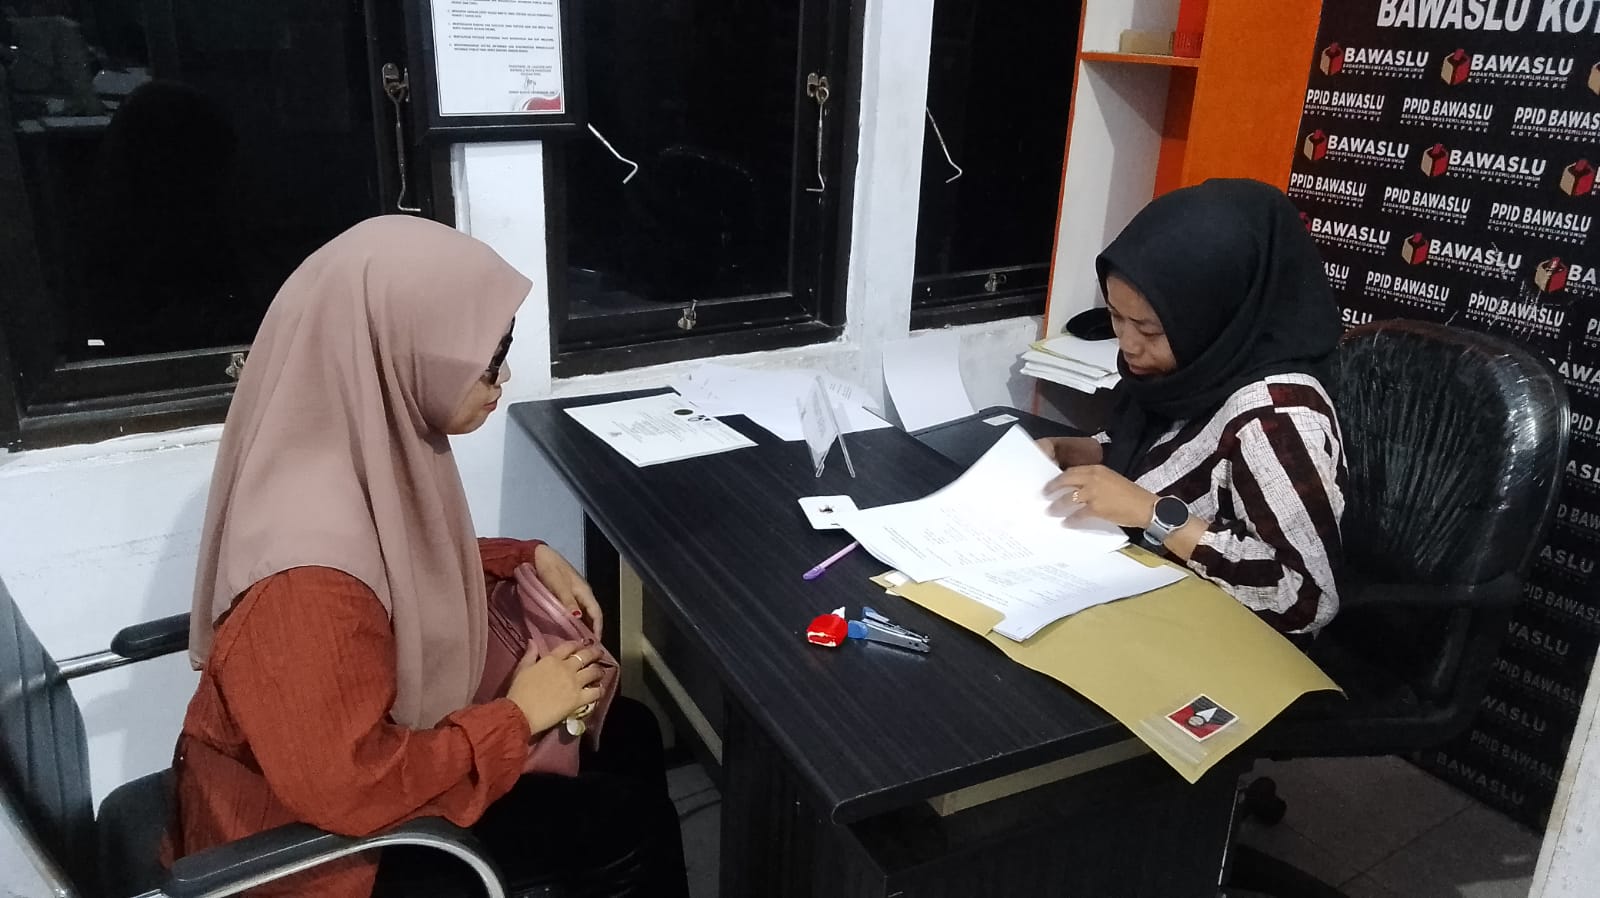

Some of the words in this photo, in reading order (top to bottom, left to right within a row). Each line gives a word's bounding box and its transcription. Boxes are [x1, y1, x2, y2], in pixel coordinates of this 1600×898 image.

[1376, 0, 1531, 31] BAWASLU
[1344, 47, 1429, 67] BAWASLU
[1470, 54, 1574, 75] BAWASLU
[1306, 89, 1330, 105] PPID
[1331, 91, 1385, 110] BAWASLU
[1402, 98, 1429, 114] PPID
[1432, 100, 1493, 120] BAWASLU
[1514, 107, 1546, 125] PPID
[1328, 135, 1409, 158] BAWASLU
[1449, 149, 1547, 176] BAWASLU
[1290, 172, 1314, 189] PPID
[1315, 177, 1367, 198] BAWASLU
[1384, 186, 1410, 204] PPID
[1412, 191, 1471, 214] BAWASLU
[1490, 202, 1520, 221] PPID
[1522, 207, 1592, 232] BAWASLU
[1311, 218, 1390, 245] BAWASLU
[1429, 239, 1522, 270] BAWASLU
[1366, 271, 1391, 288] PPID
[1394, 277, 1450, 301] BAWASLU
[1468, 293, 1497, 312] PPID
[1500, 300, 1564, 327] BAWASLU
